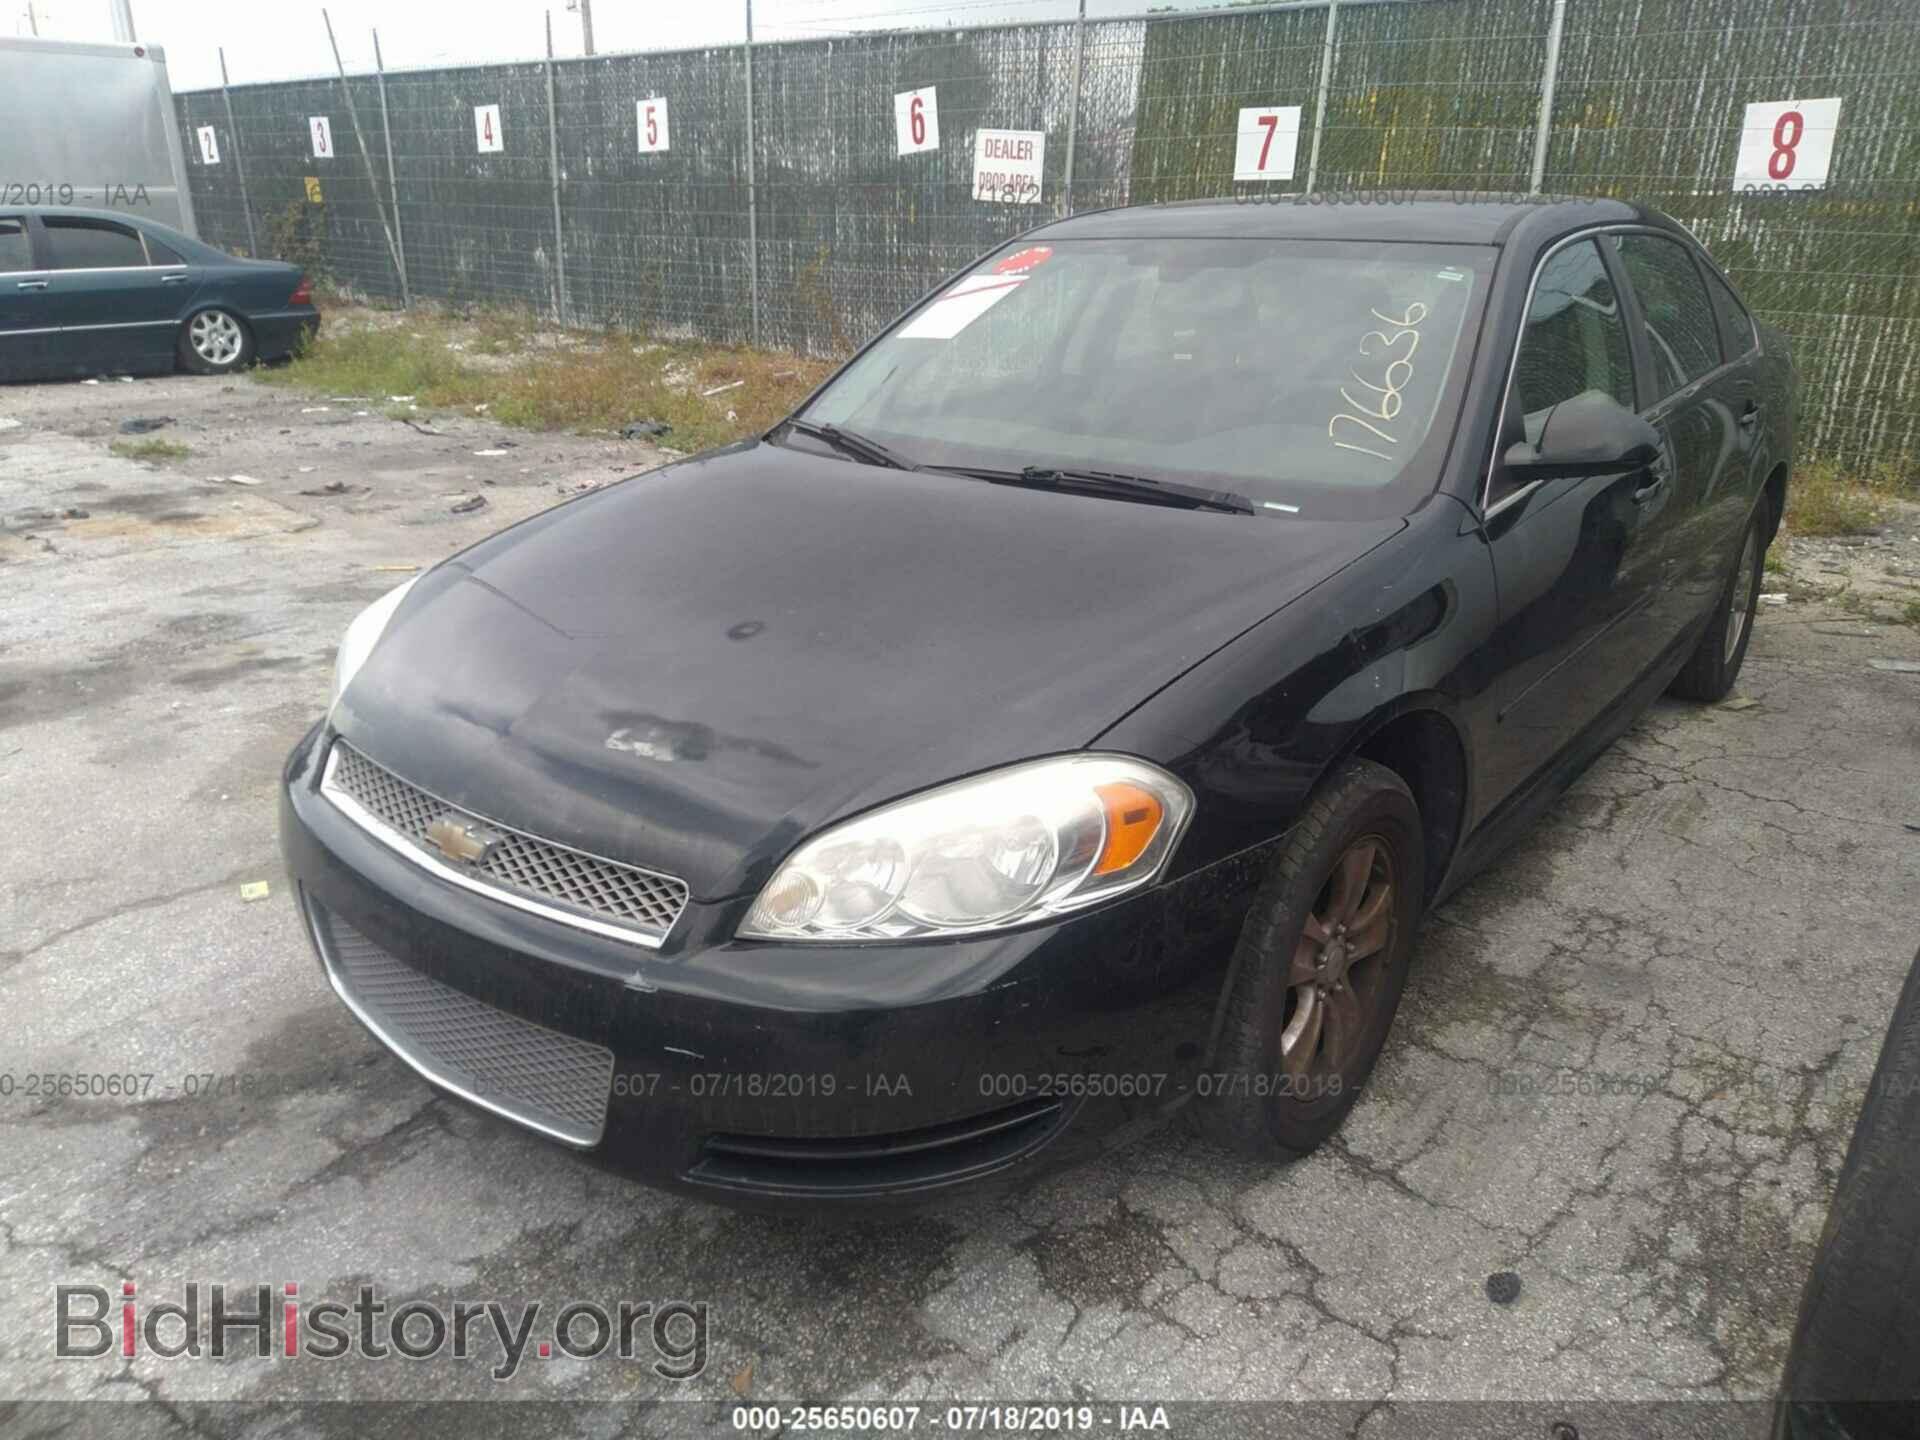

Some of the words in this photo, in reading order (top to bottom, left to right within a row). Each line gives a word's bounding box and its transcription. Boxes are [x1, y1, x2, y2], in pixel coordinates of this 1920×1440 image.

[316, 120, 327, 153] 3
[483, 111, 494, 147] 4
[645, 105, 658, 146] 5
[910, 97, 926, 146] 6
[203, 131, 215, 160] 2
[984, 138, 1033, 160] DEALER
[1257, 115, 1279, 171] 7
[1768, 111, 1804, 181] 8
